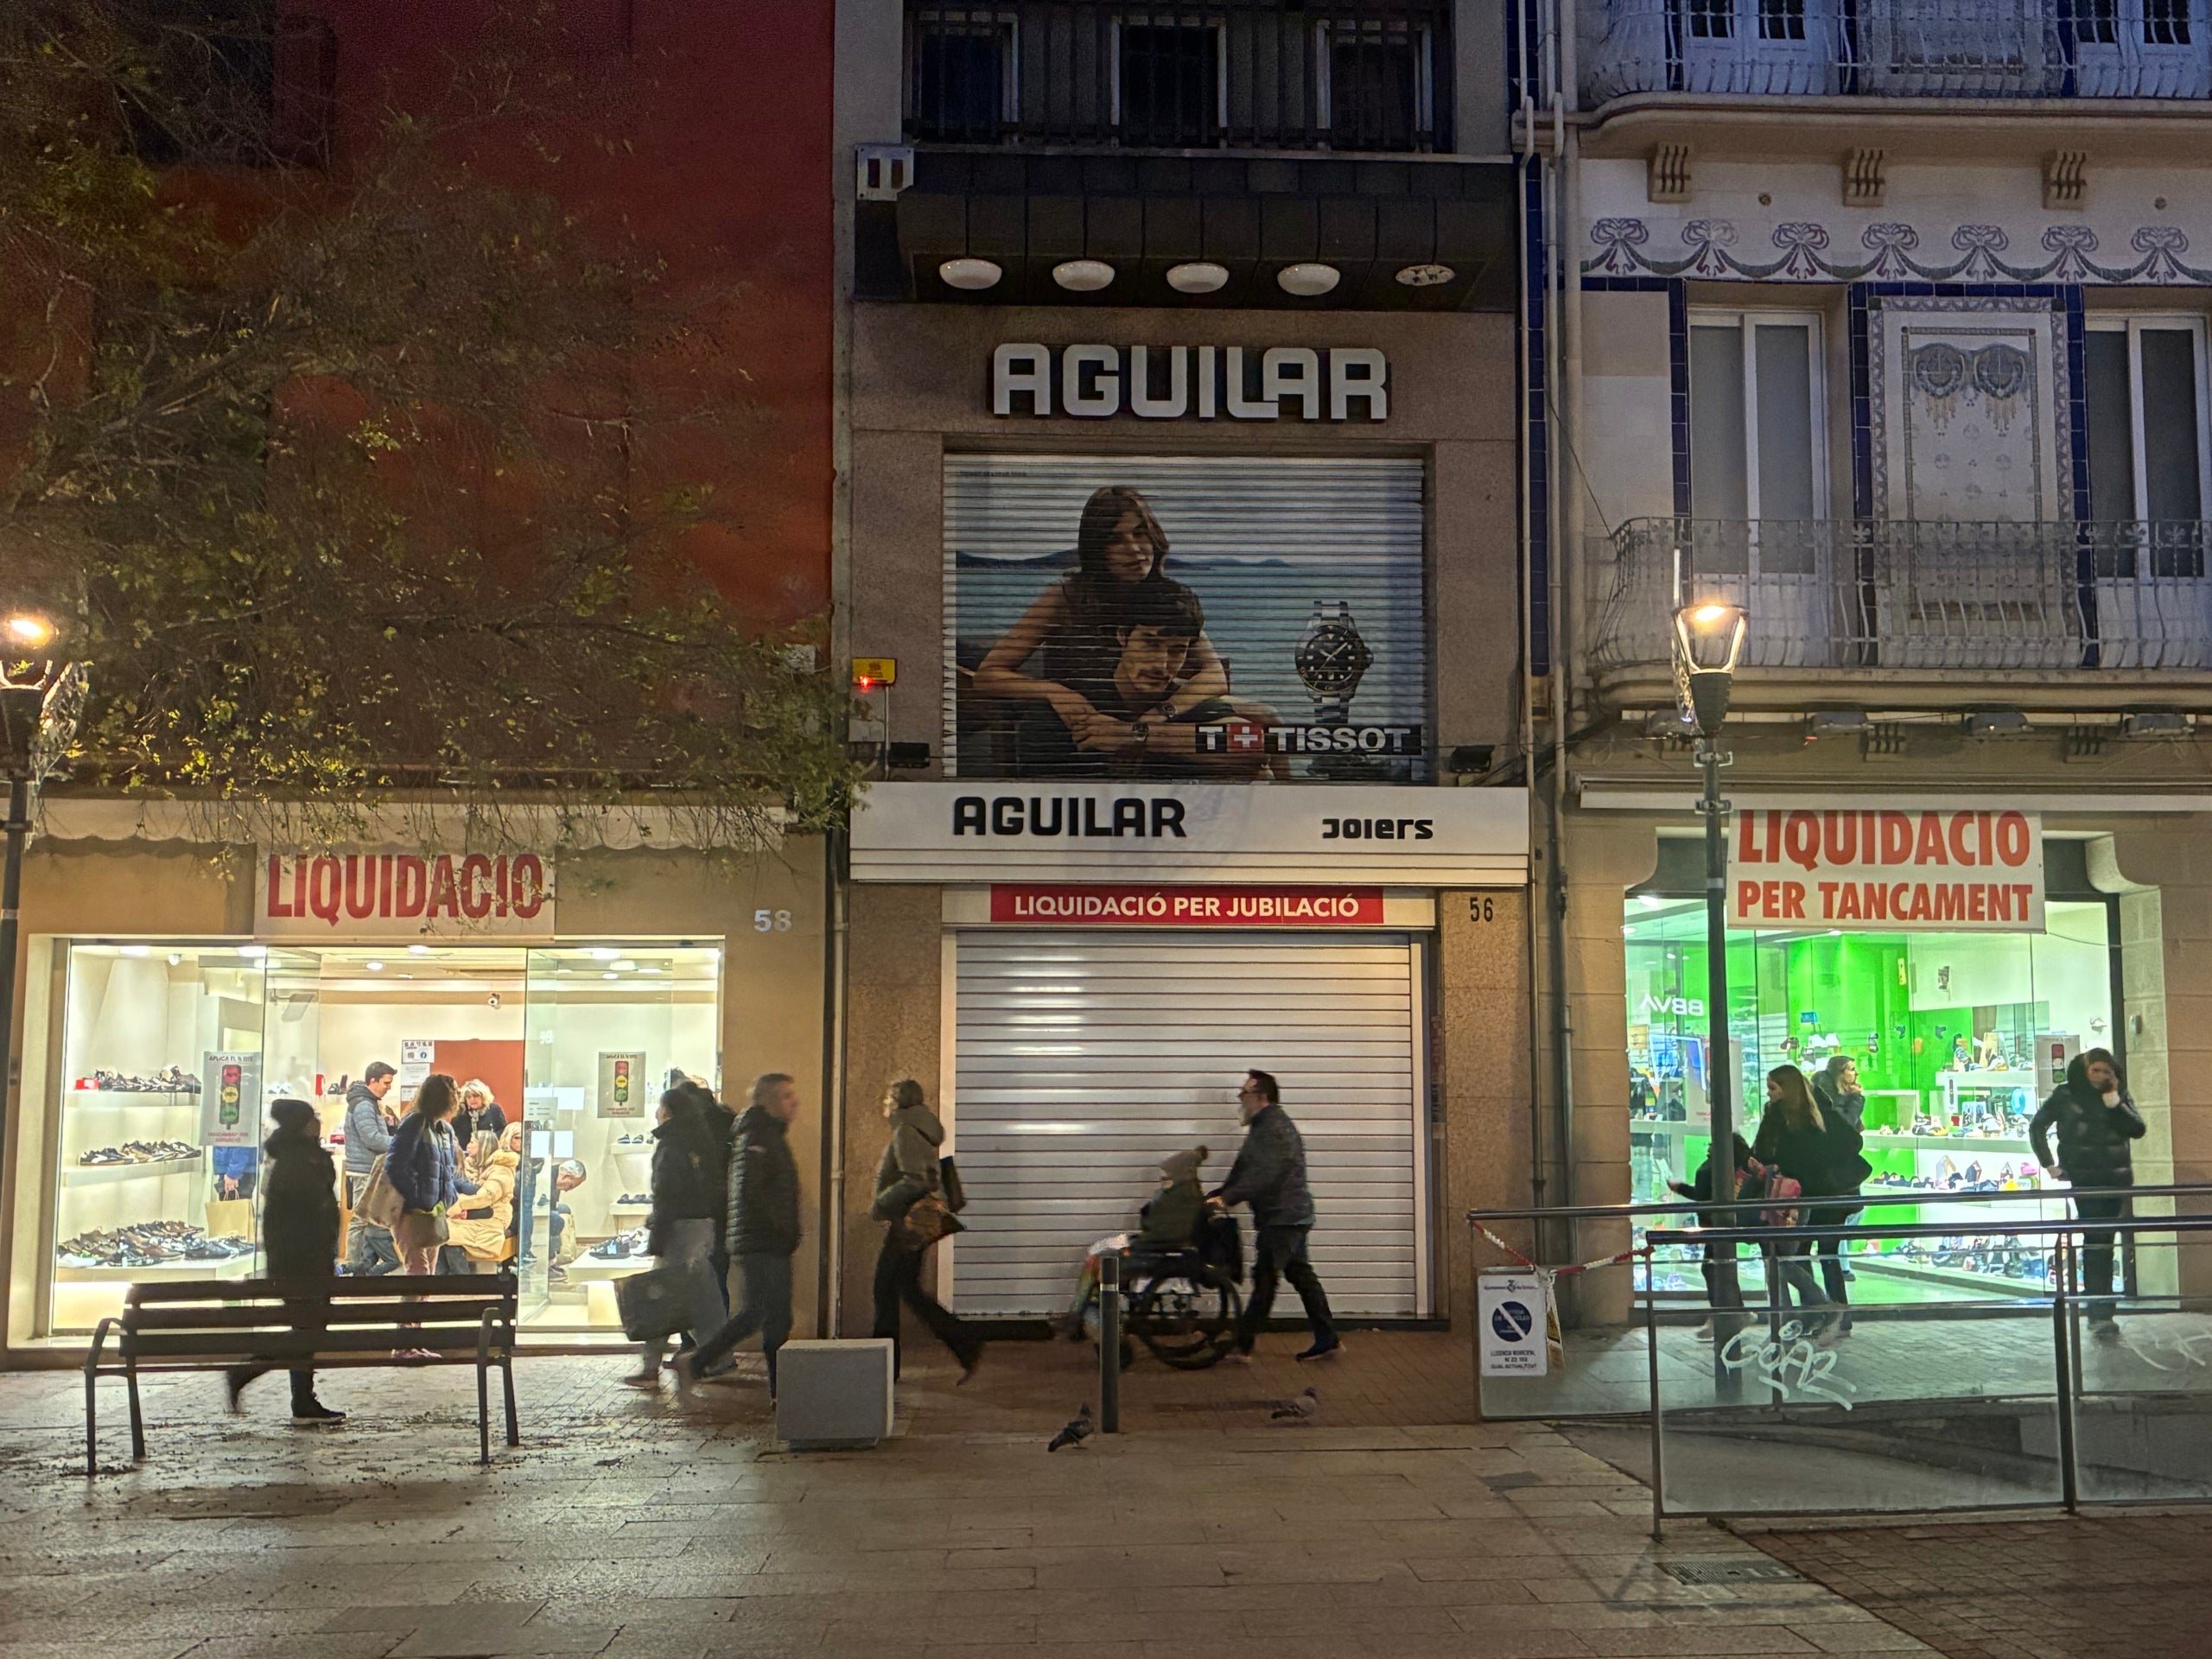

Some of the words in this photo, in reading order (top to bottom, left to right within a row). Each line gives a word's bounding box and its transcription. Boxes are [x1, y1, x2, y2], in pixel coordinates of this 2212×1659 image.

[993, 343, 1388, 420] AGUILAR
[1268, 728, 1410, 753] TISSOT
[953, 797, 1186, 837] AGUILAR
[1738, 810, 2030, 871] LIQUIDACIO
[268, 853, 543, 927] LIQUIDACIO
[1014, 893, 1167, 917] LIQUIDACIÓ
[1174, 899, 1219, 917] PER
[1226, 893, 1359, 918] JUBILACIÓ
[1470, 897, 1494, 923] 56
[1738, 880, 1805, 918] PER
[1818, 881, 2032, 922] TANCAMENT
[753, 909, 792, 932] 58
